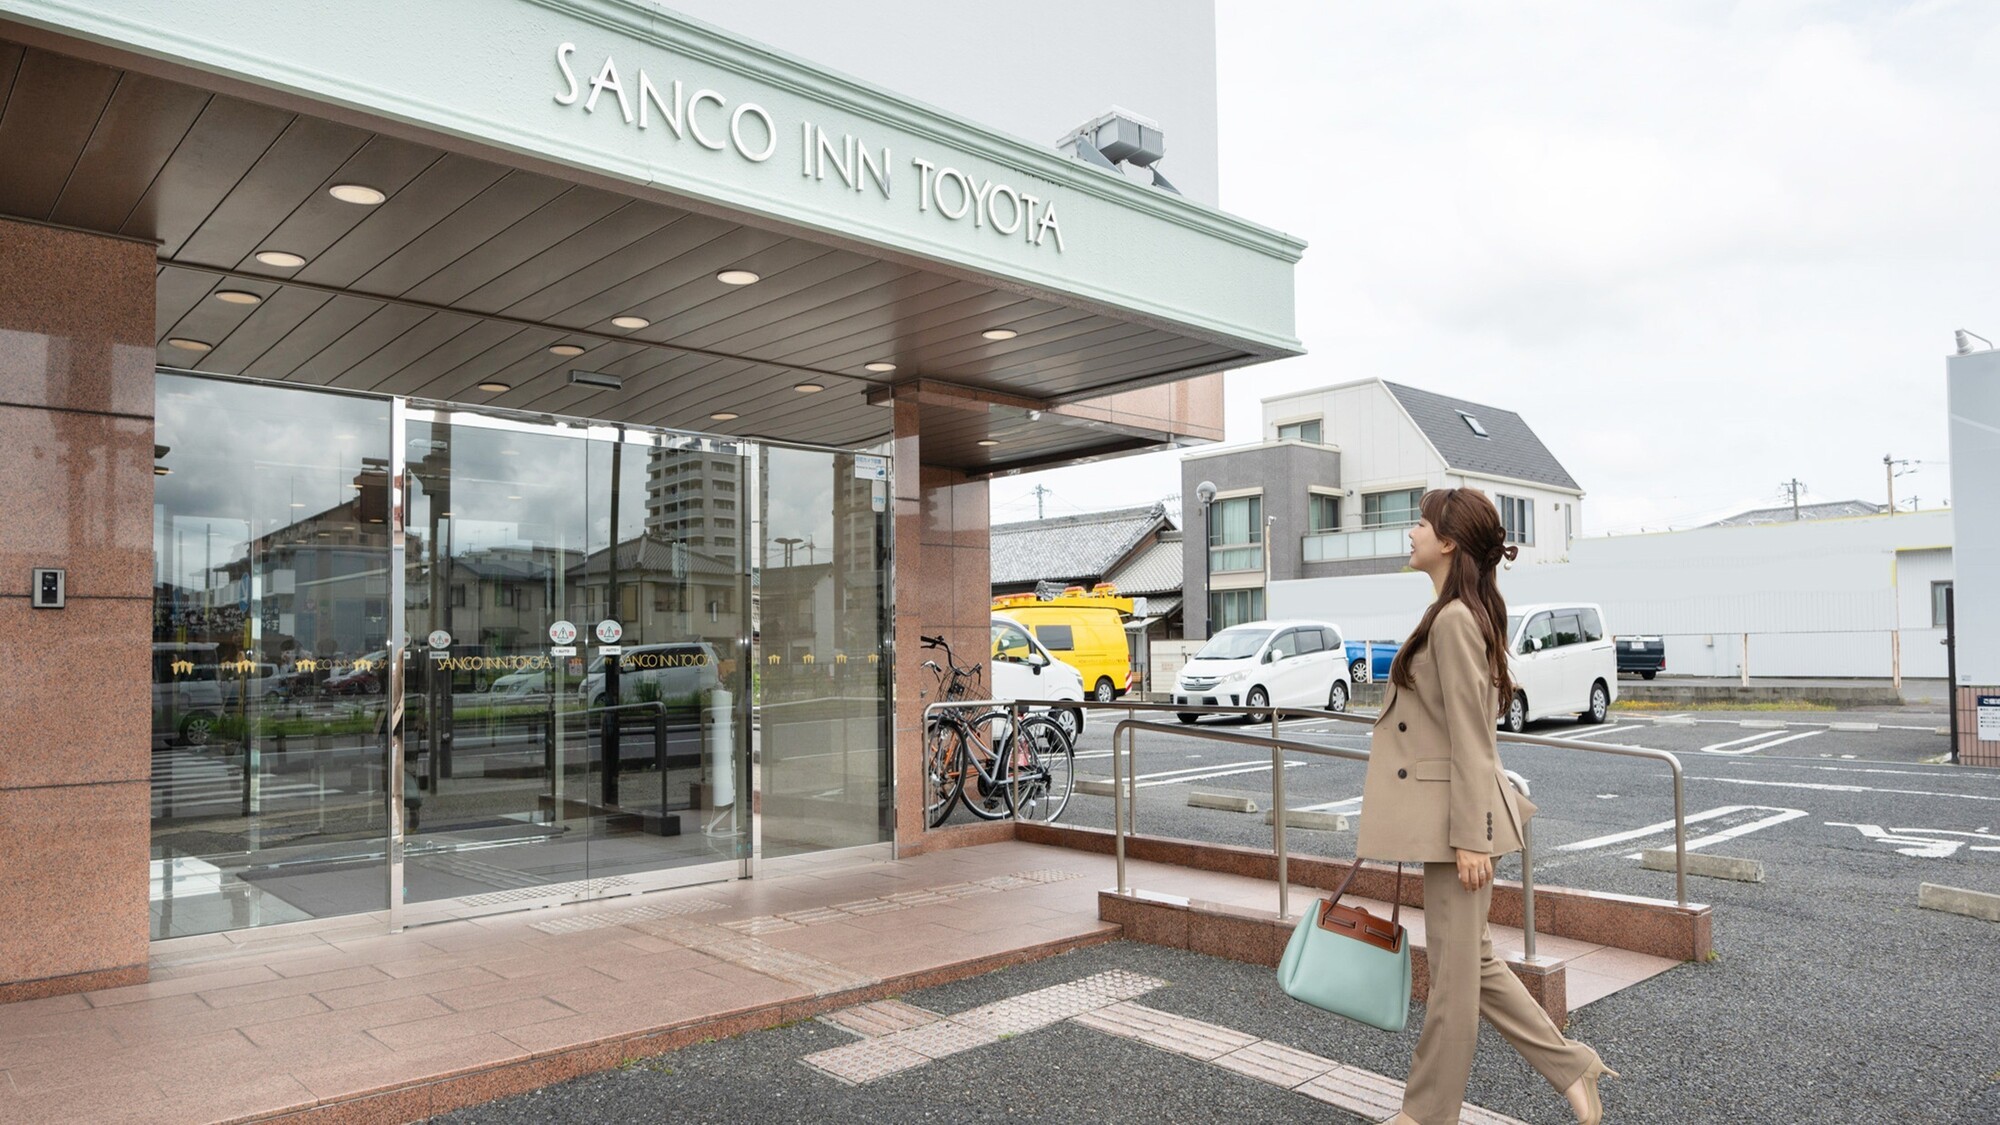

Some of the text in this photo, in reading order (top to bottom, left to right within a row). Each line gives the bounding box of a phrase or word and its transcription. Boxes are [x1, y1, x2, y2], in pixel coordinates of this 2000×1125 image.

[553, 42, 1065, 254] SANCO INN TOYOTA
[438, 656, 553, 671] SANCO INN TOYOTA
[619, 654, 715, 668] SANCO INN TOYOTA
